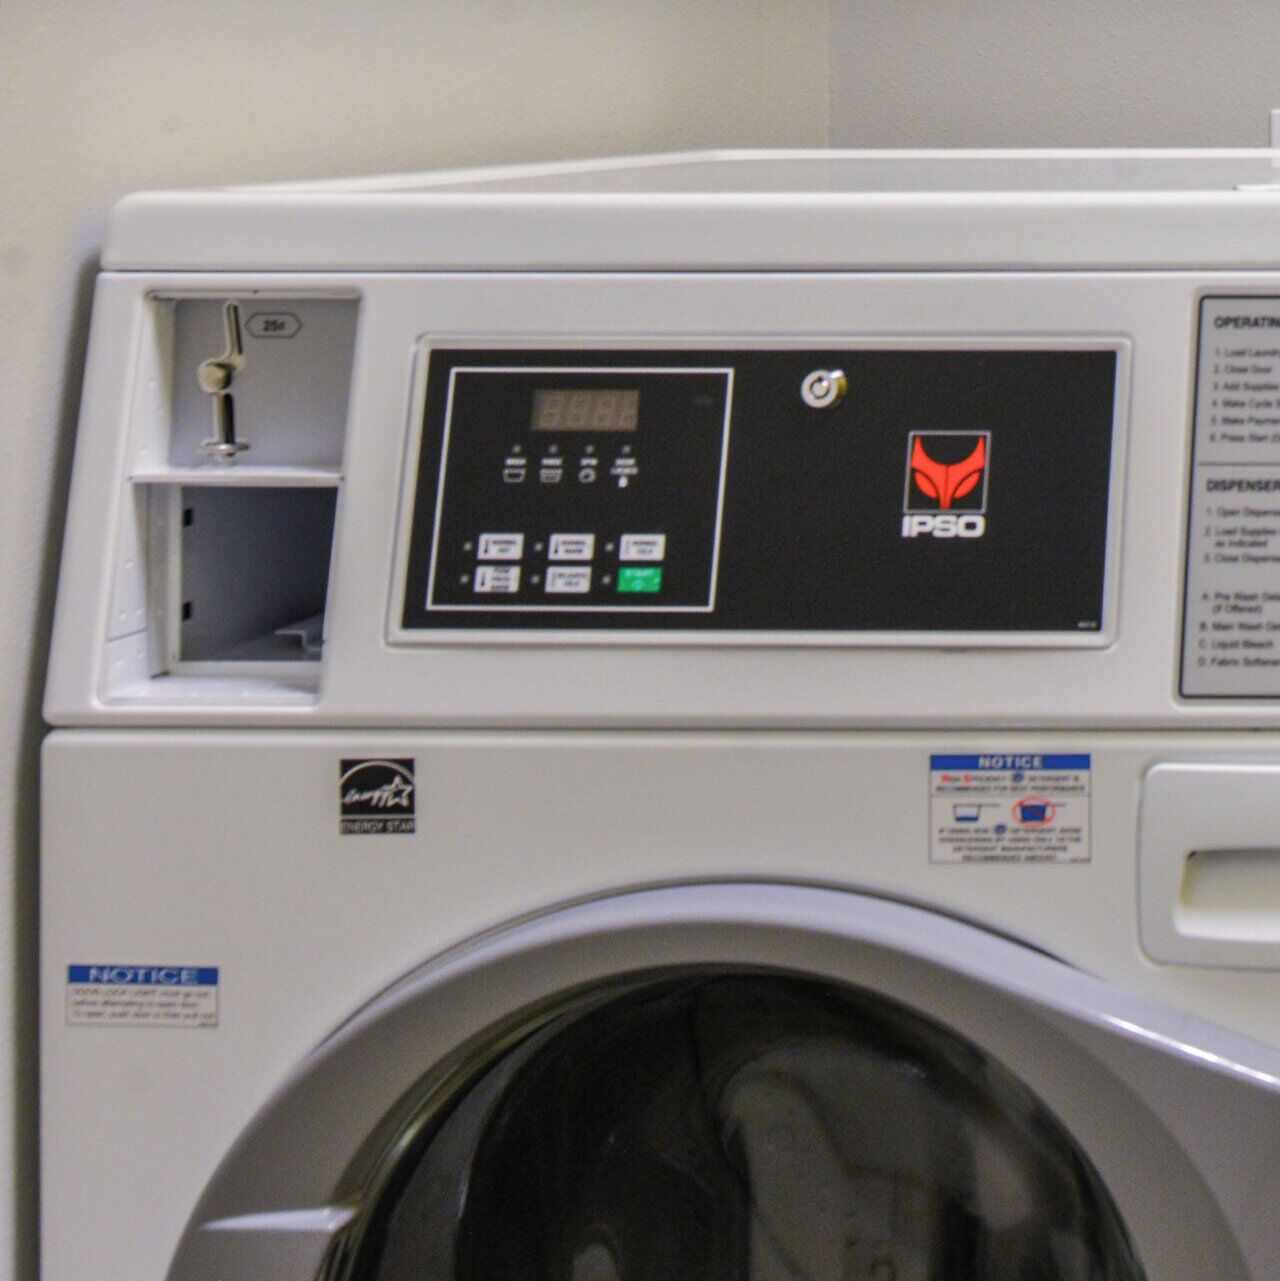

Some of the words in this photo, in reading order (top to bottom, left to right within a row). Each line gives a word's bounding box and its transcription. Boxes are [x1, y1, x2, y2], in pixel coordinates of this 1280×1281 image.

[902, 514, 985, 538] IPSO
[978, 755, 1043, 769] NOTICE
[89, 967, 199, 984] NOTICE
